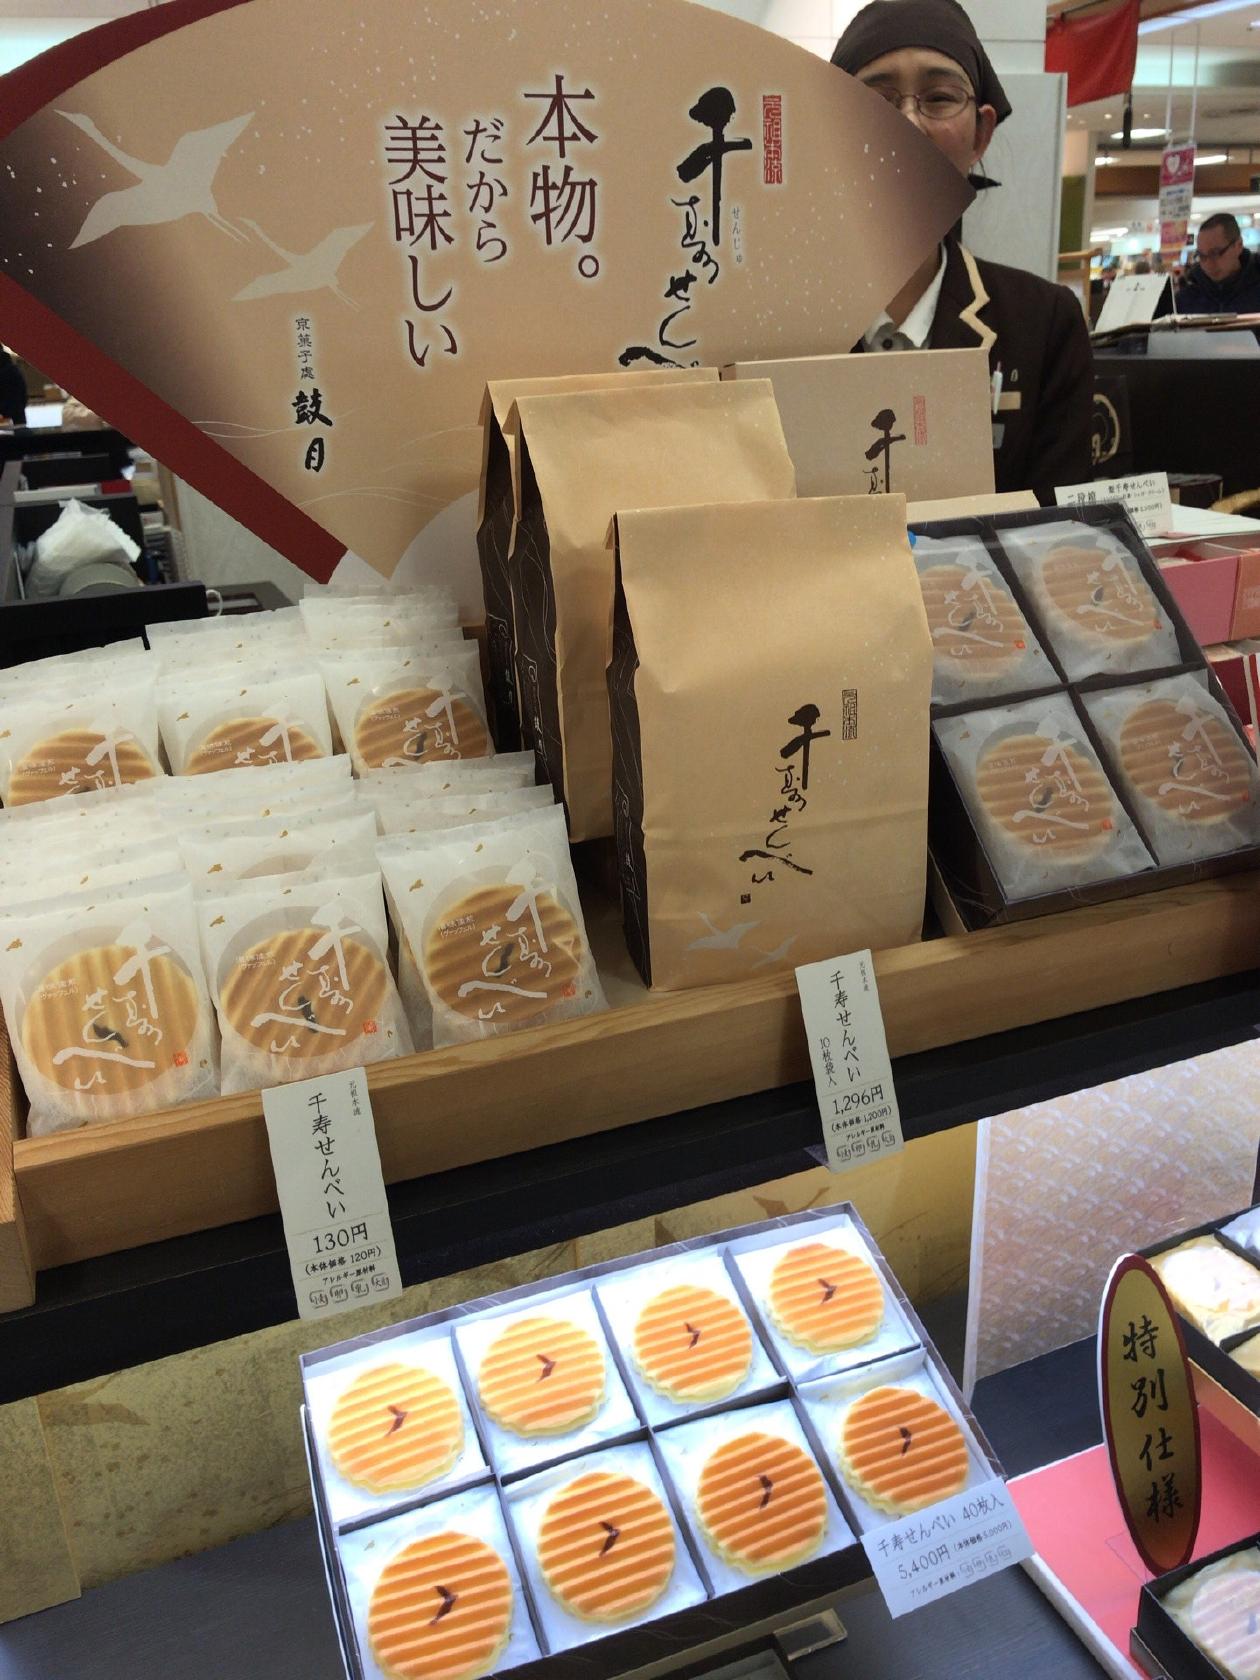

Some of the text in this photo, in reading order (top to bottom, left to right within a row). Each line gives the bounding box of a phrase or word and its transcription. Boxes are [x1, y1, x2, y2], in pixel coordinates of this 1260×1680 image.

[463, 118, 508, 262] だから
[523, 74, 599, 278] 本物。
[384, 114, 458, 367] 美味しい
[731, 207, 743, 263] せんじゅ
[292, 388, 333, 472] 鼓月
[820, 1036, 837, 1088] 10枚袋入
[830, 970, 861, 1082] 千寿せんべい
[832, 1084, 884, 1115] 1,296円
[308, 1092, 346, 1218] 千寿せんべい
[313, 1222, 368, 1253] 130円
[1122, 1315, 1184, 1523] 特別仕様
[878, 1493, 1005, 1558] 千寿せんべい 40枚入
[898, 1544, 950, 1580] 5,400円
